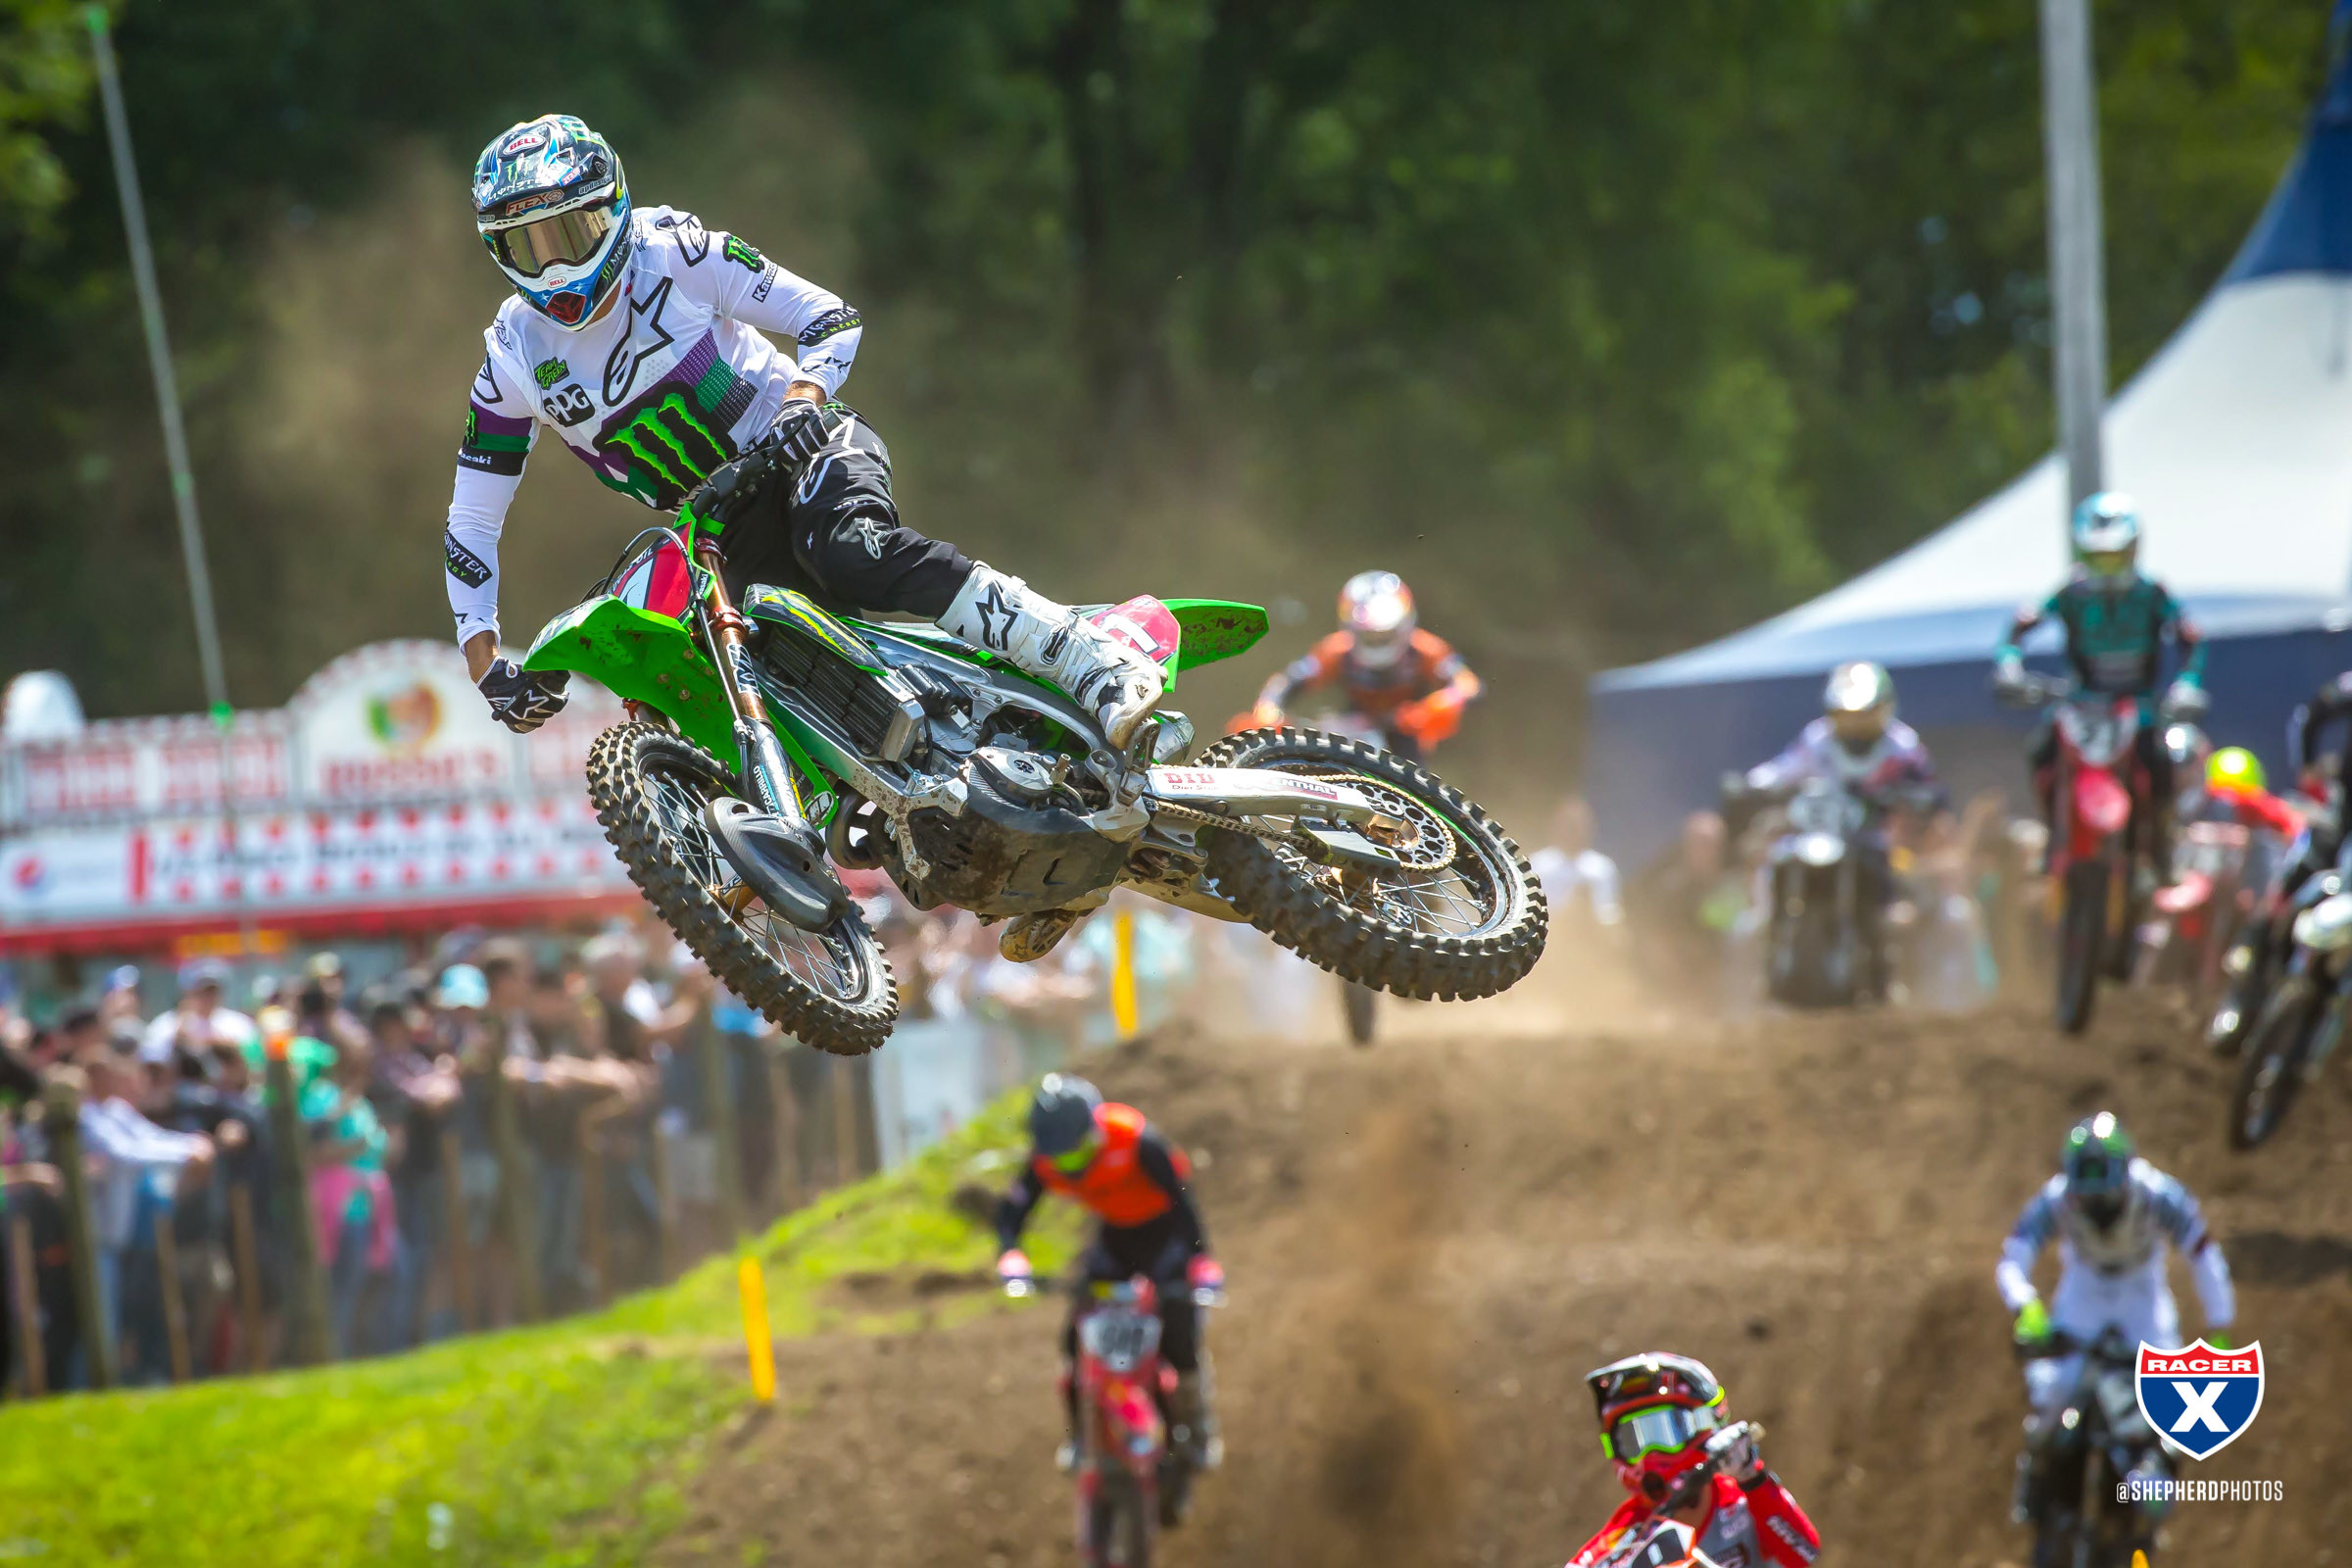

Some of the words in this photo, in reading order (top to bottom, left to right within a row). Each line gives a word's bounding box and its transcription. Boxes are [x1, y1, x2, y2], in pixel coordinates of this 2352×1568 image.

[509, 137, 538, 151] BELL
[506, 193, 549, 215] FLEX
[535, 360, 558, 381] TEAM
[542, 362, 566, 388] GREEN
[444, 532, 488, 579] ONSTER
[1280, 779, 1336, 796] NTHAL
